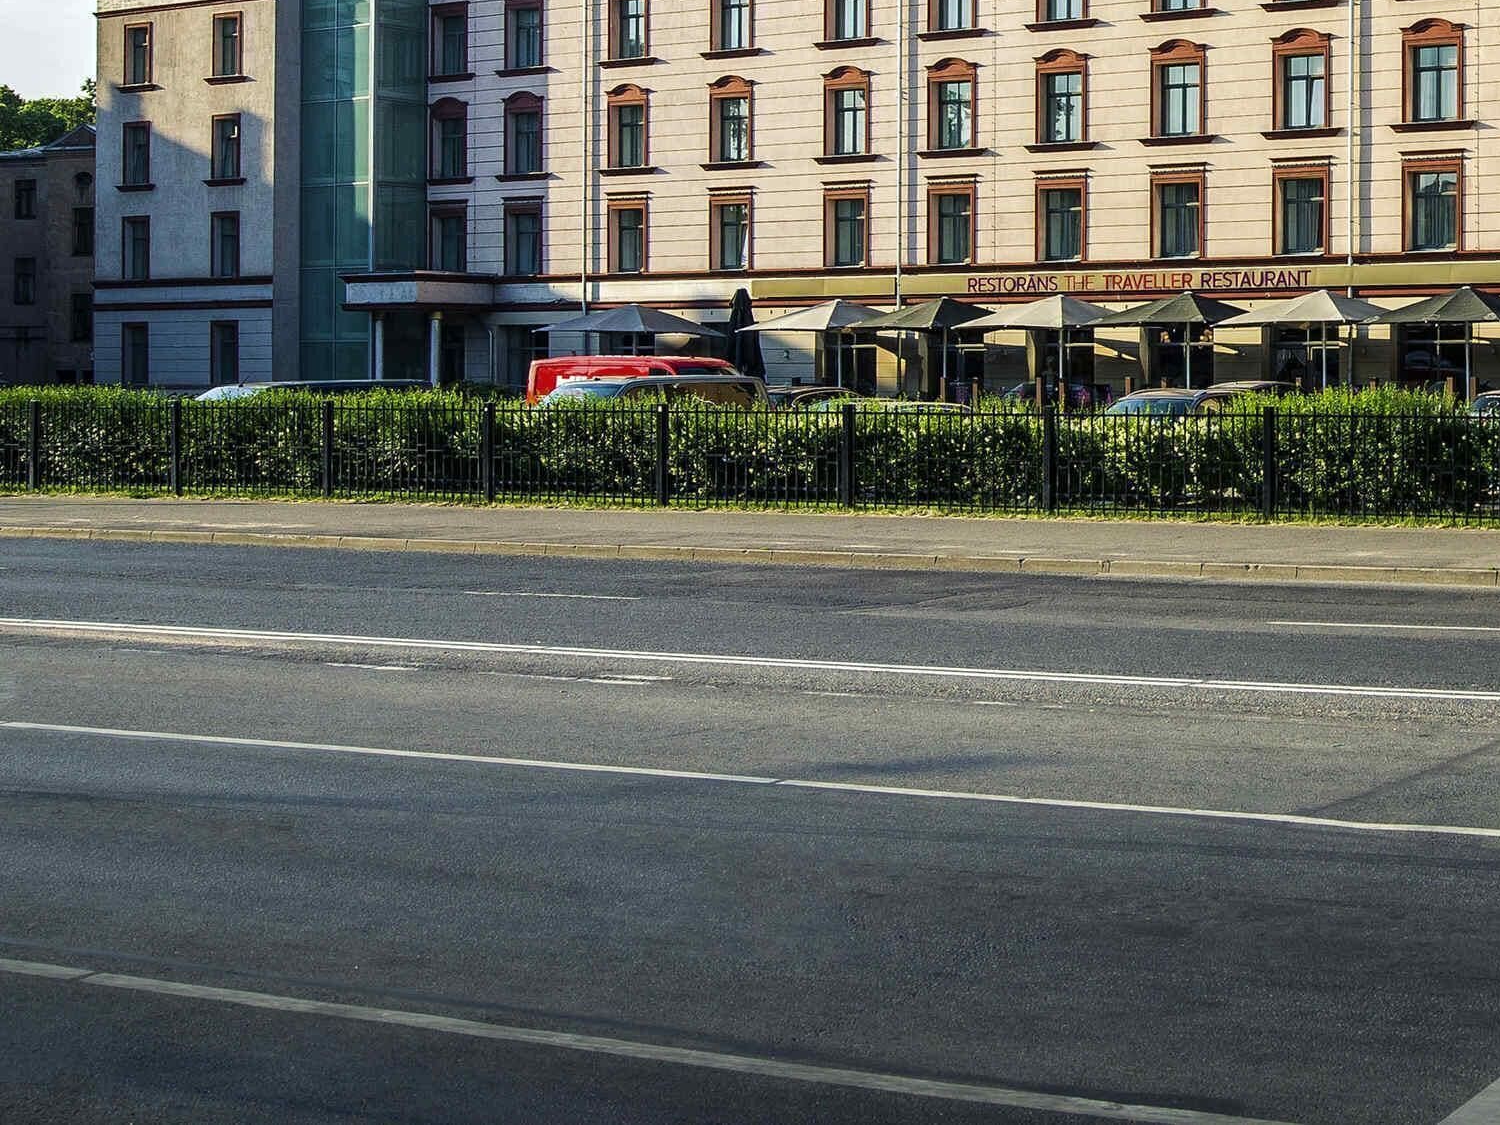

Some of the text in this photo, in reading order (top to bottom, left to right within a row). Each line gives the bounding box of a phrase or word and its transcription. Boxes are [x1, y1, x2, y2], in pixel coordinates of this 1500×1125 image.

[1064, 274, 1096, 291] THE
[1103, 273, 1193, 290] TRAVELLER
[1200, 270, 1312, 288] RESTAURANT
